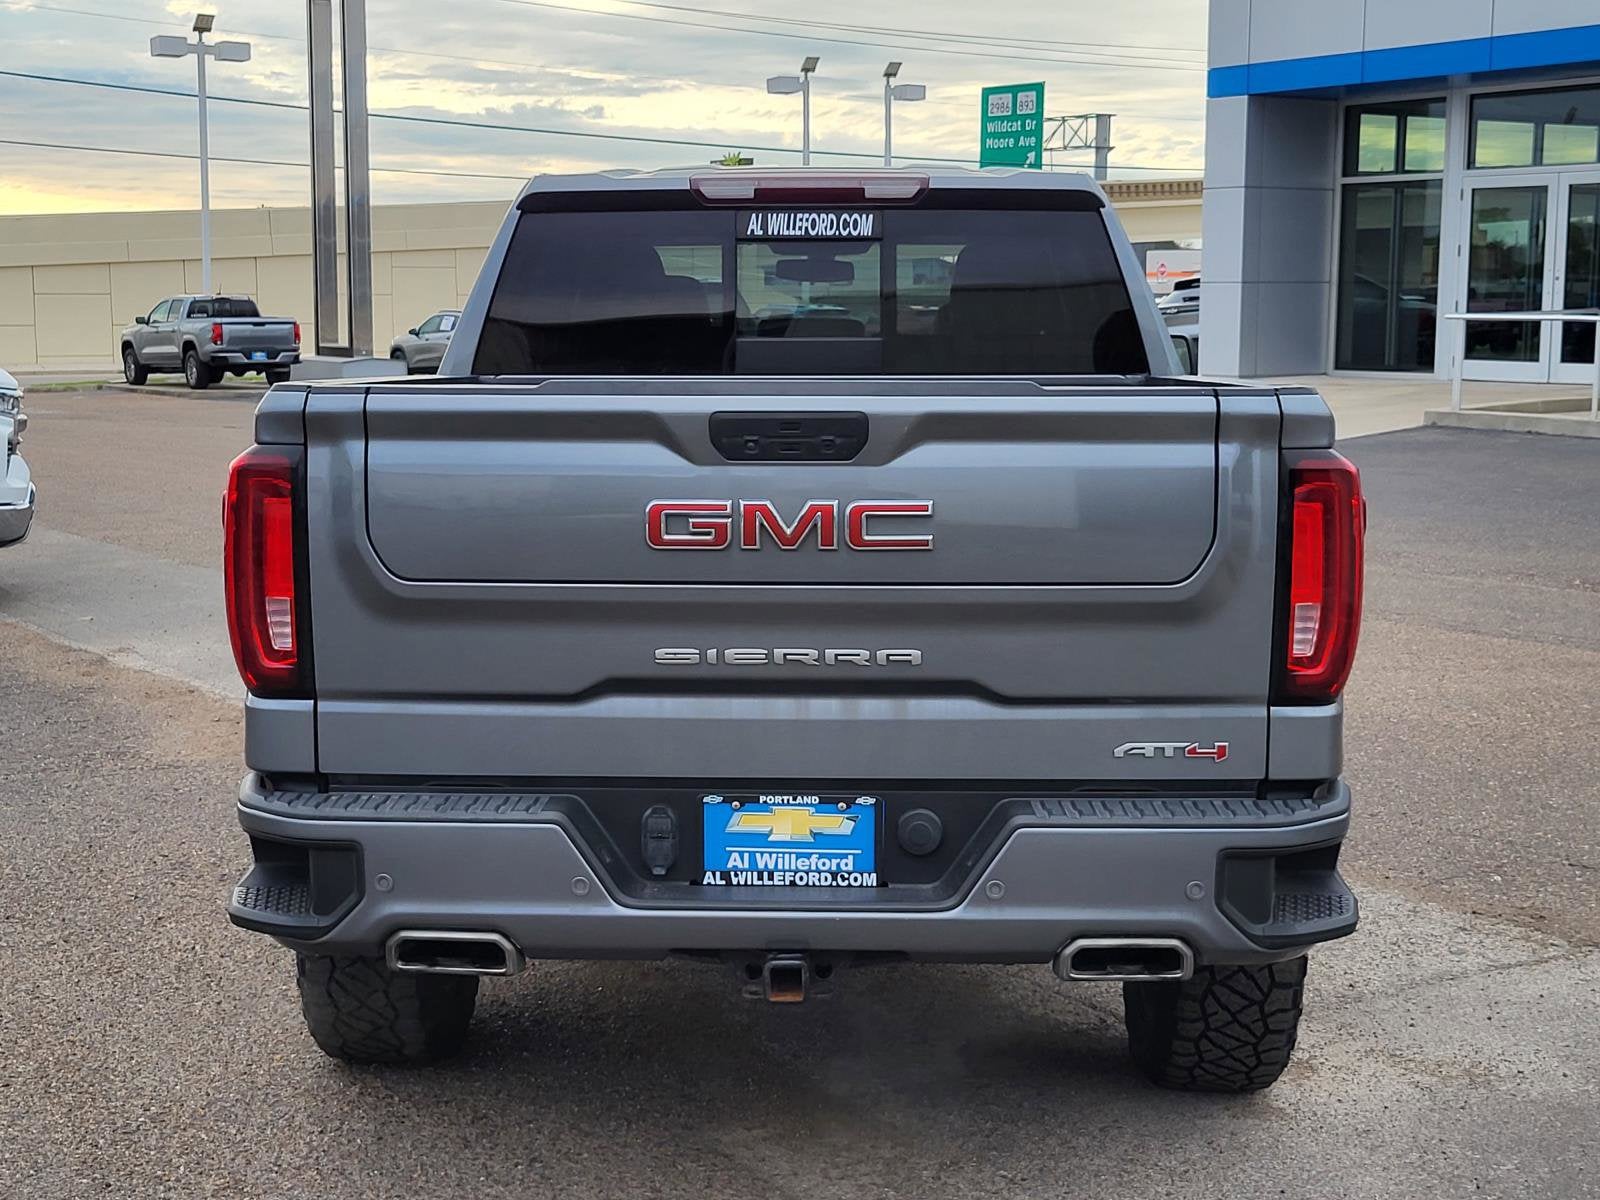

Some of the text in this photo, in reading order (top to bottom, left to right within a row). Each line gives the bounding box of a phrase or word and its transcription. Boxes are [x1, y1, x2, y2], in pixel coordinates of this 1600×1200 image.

[990, 102, 1010, 114] 2986
[1018, 100, 1035, 112] 893
[986, 119, 1036, 133] Wildcat Dr
[986, 136, 1036, 149] Moore Ave
[746, 212, 873, 236] AL WILLEFORD.COM
[645, 498, 934, 551] GMC
[654, 647, 923, 667] SIERRA
[1113, 742, 1229, 763] AT4
[759, 795, 819, 804] PORTLAND
[726, 852, 854, 871] Al Willeford
[702, 871, 877, 886] AL WILLEFORD.COM
